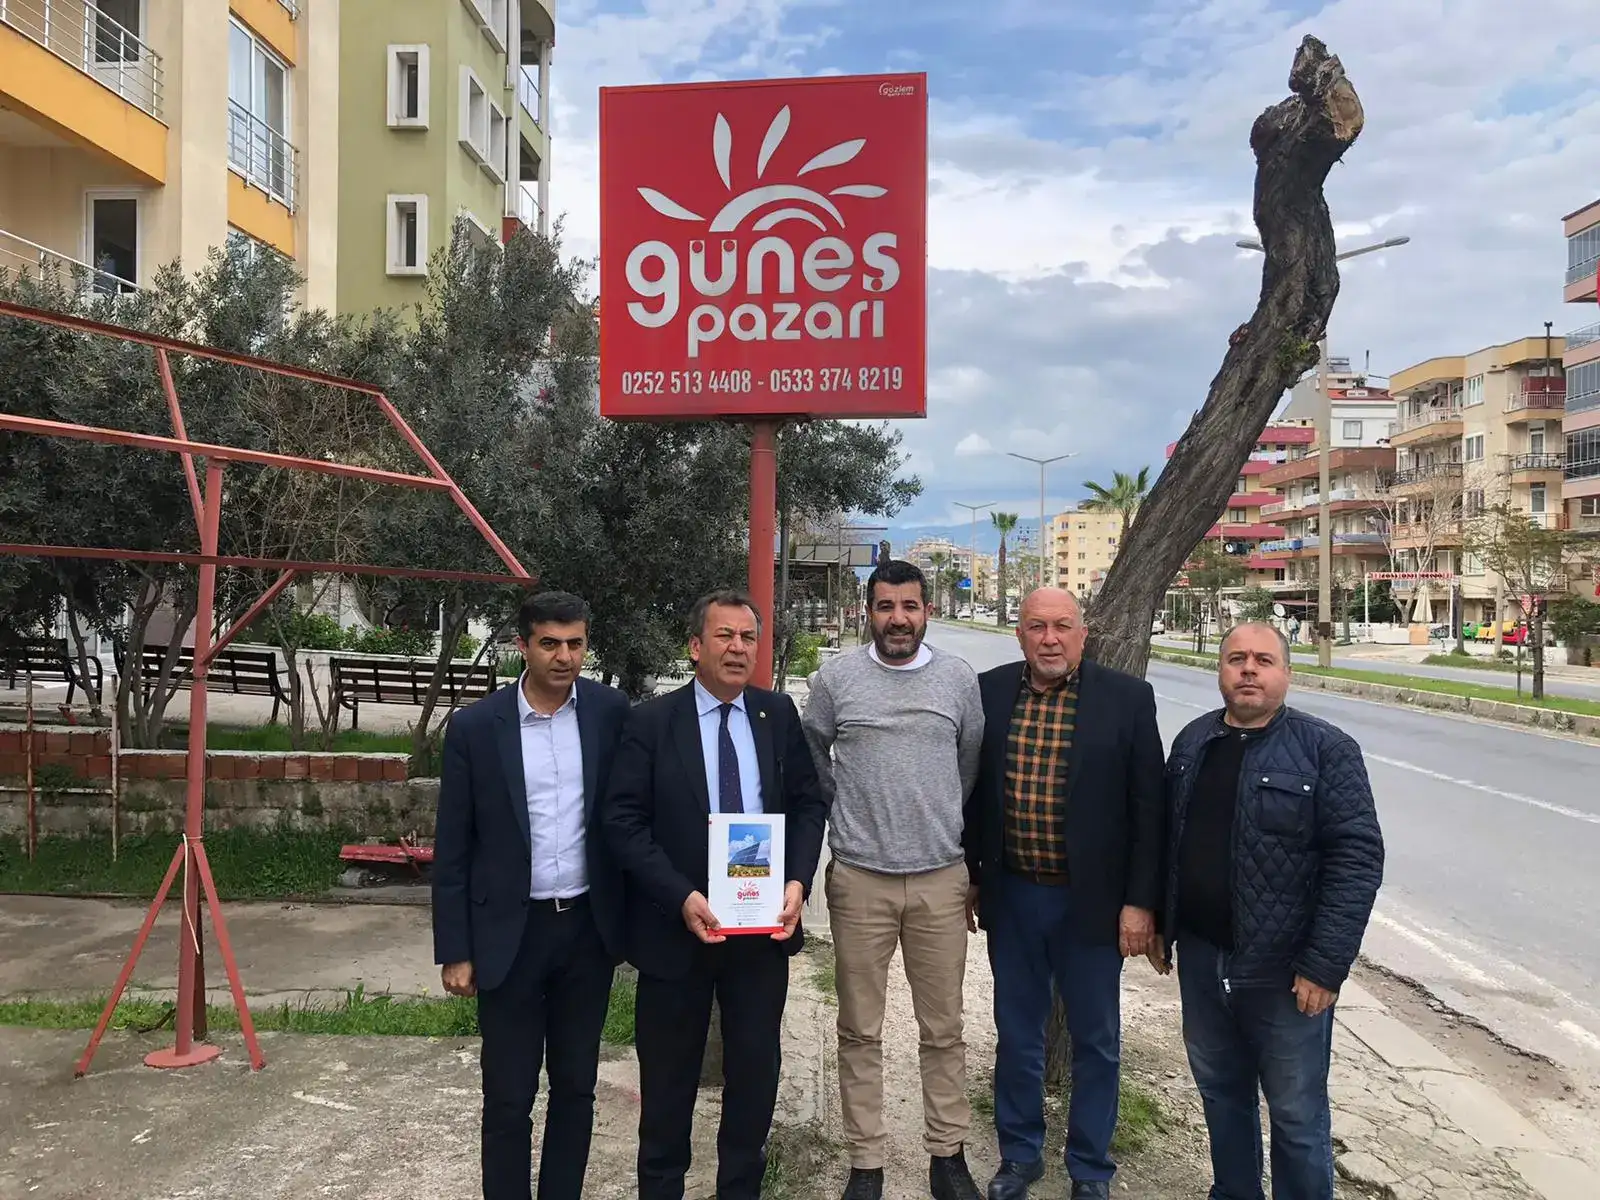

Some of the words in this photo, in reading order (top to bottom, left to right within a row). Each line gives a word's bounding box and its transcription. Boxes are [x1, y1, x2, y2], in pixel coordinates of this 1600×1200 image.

[625, 231, 901, 328] güneş
[687, 300, 884, 358] pazarı
[622, 371, 665, 395] 0252
[670, 370, 703, 394] 513
[708, 369, 752, 393] 4408
[770, 368, 814, 393] 0533
[819, 367, 852, 392] 374
[858, 366, 903, 391] 8219
